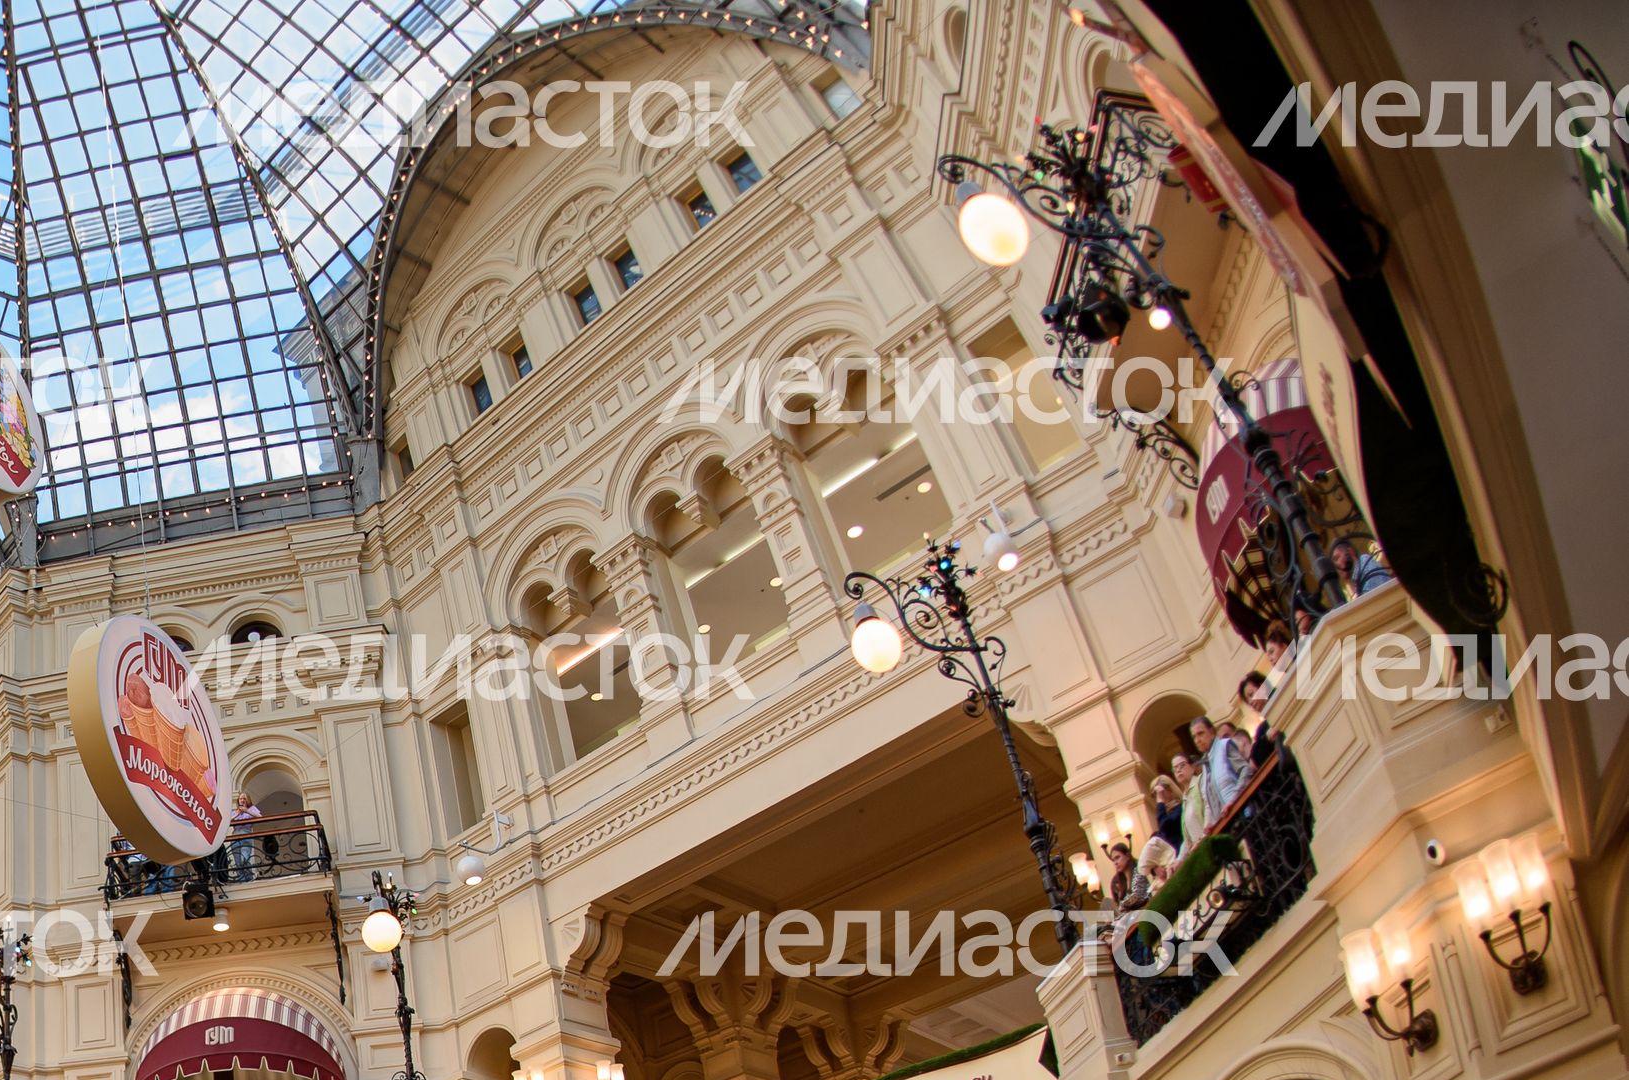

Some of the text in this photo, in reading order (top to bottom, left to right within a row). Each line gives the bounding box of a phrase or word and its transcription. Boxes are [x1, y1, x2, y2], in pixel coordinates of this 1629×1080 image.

[143, 631, 190, 710] ГУМ
[126, 744, 214, 832] Мороженое
[205, 1025, 235, 1046] ГУМ
